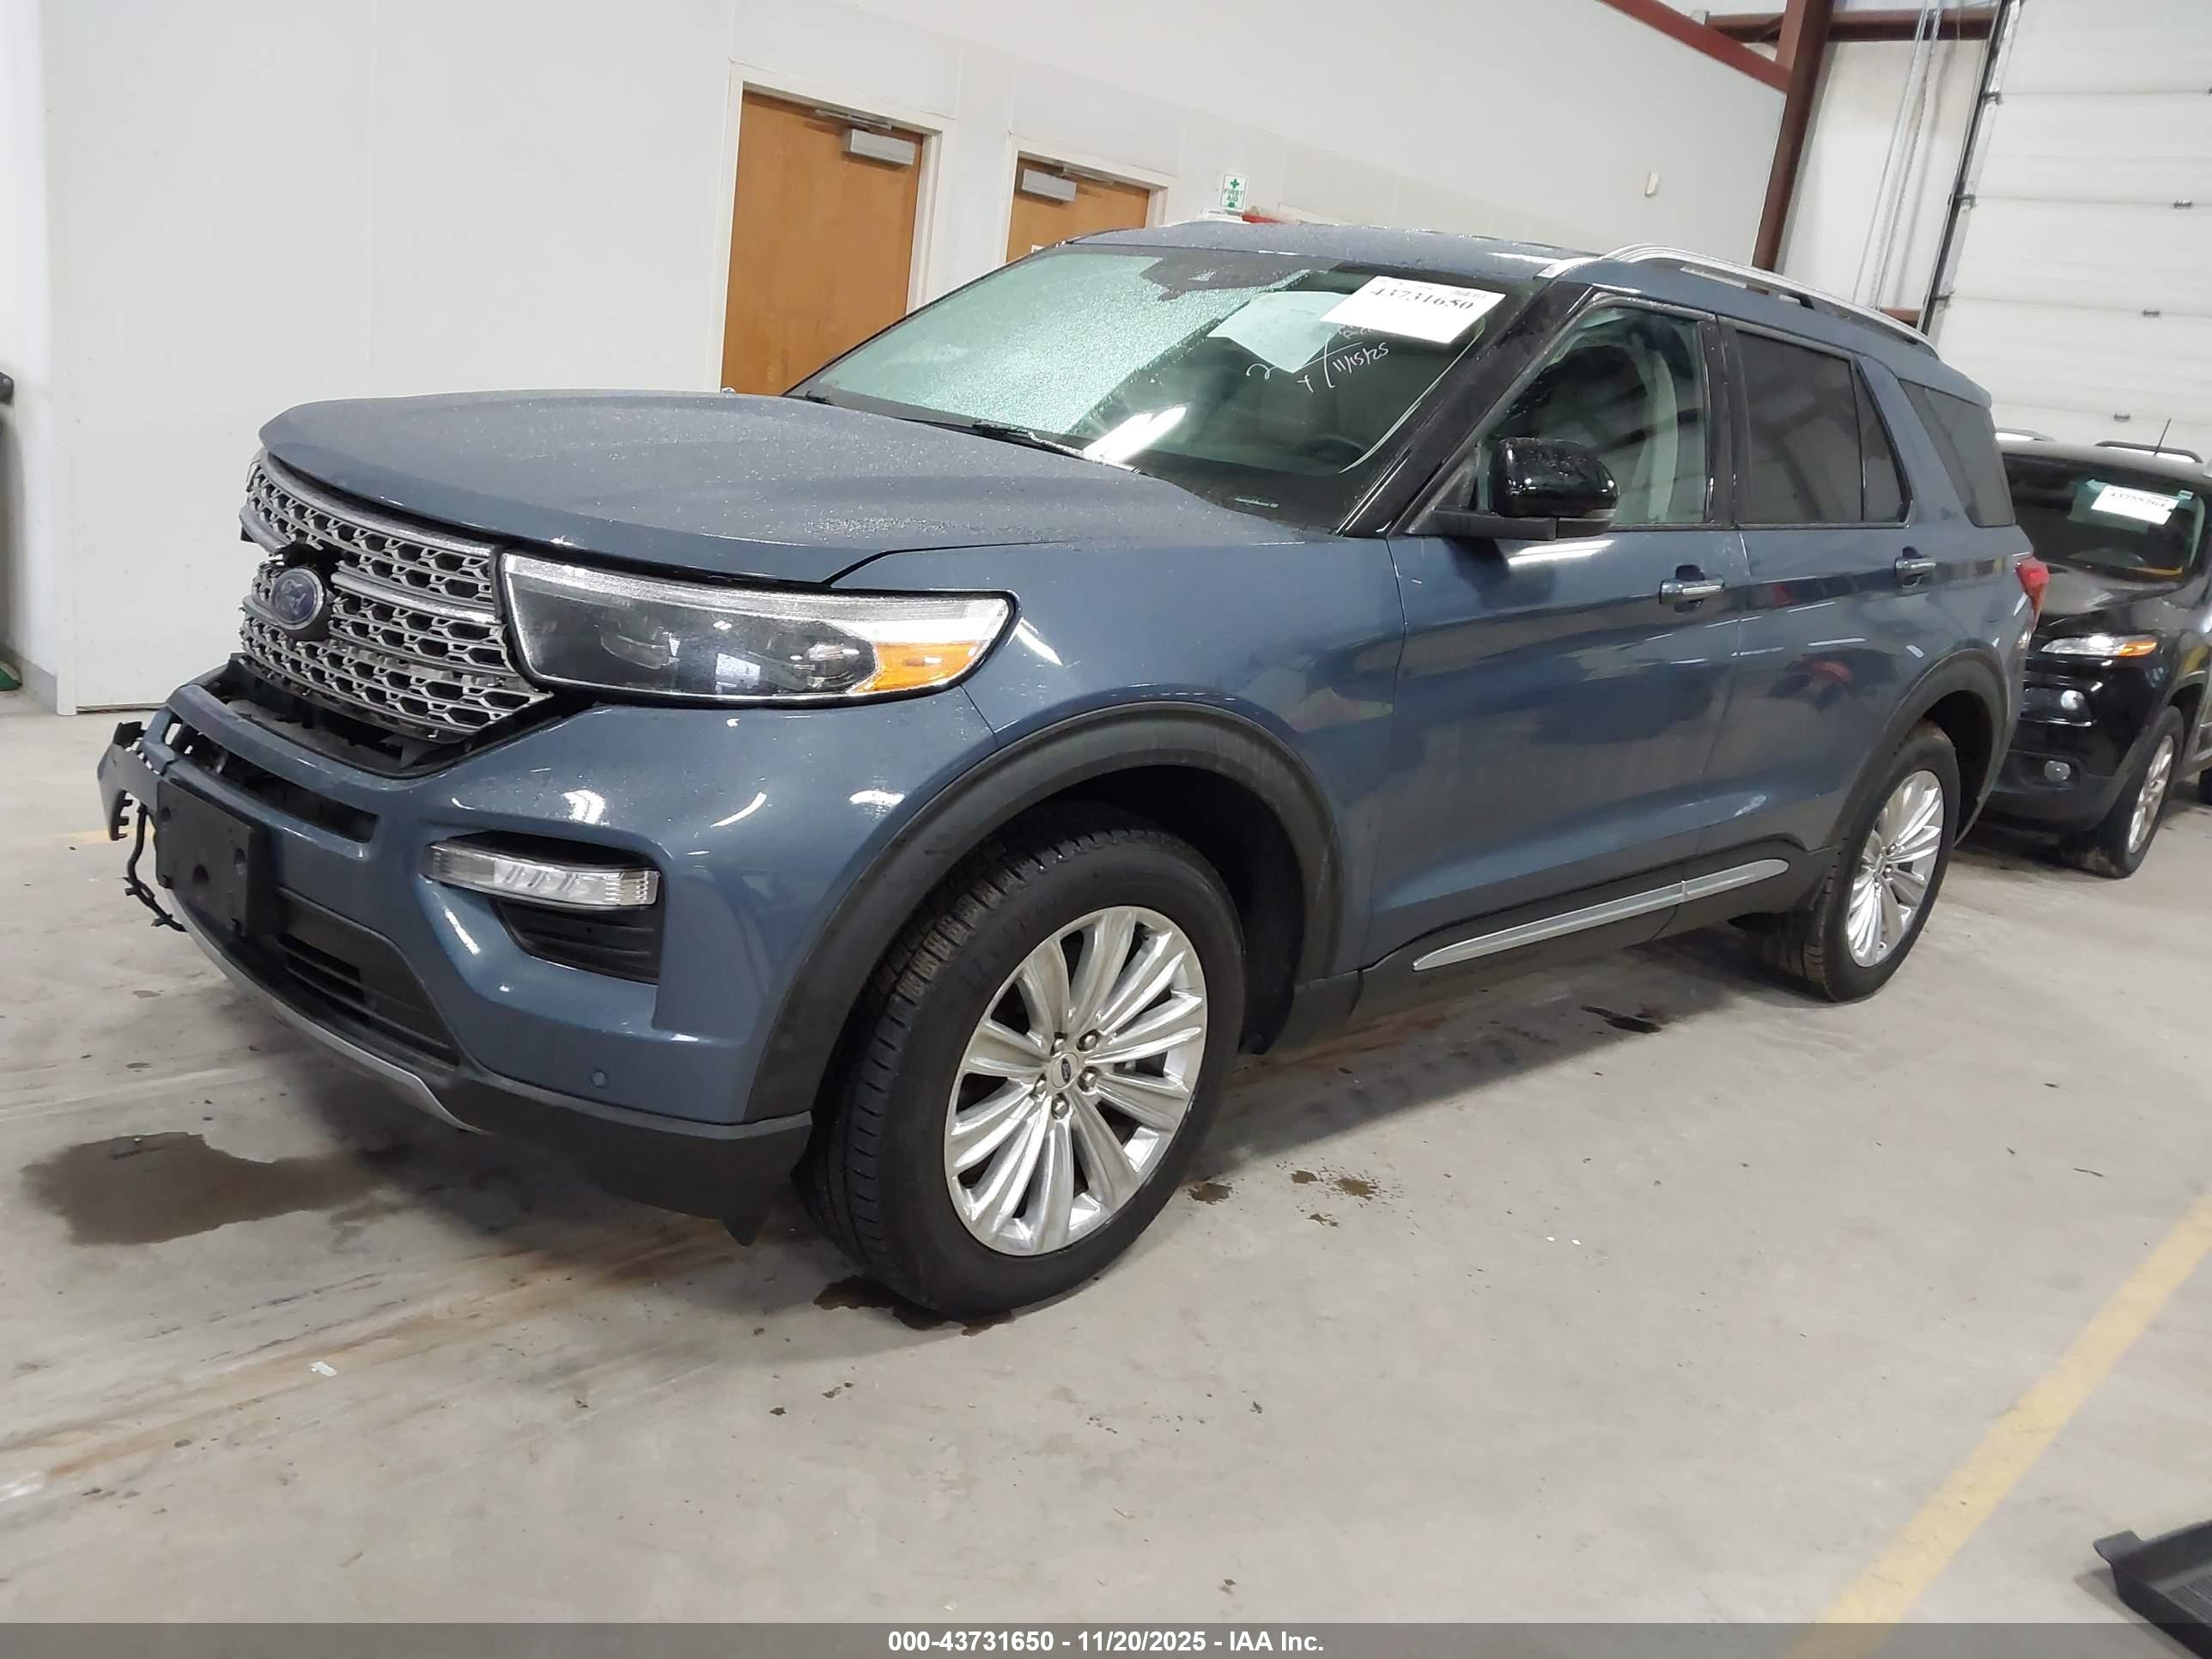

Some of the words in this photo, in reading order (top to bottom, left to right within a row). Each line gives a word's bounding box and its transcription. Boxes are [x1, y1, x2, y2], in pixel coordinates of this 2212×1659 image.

[1224, 188, 1243, 197] FIRST
[1370, 288, 1474, 310] 43731650
[1333, 342, 1389, 374] 11/15/25
